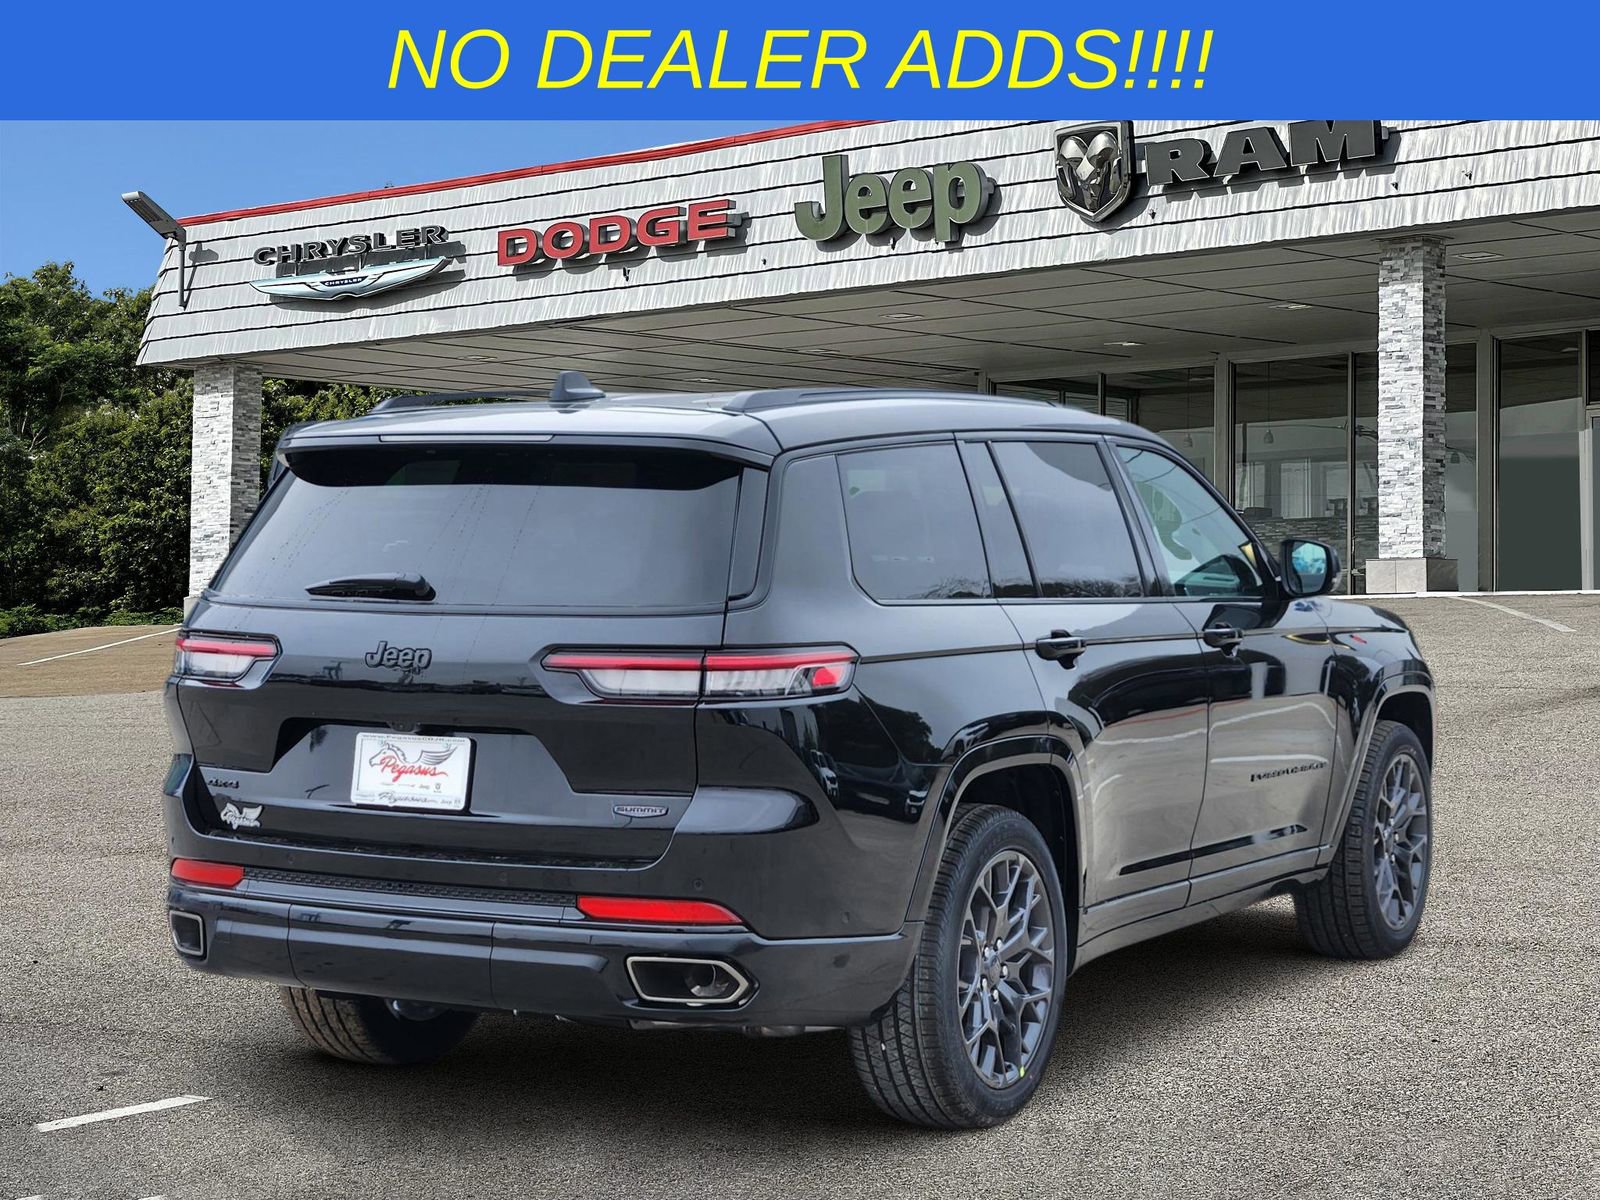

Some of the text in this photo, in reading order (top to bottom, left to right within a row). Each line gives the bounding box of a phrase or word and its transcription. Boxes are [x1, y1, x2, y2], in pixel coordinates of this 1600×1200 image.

[1145, 120, 1378, 187] RAM
[794, 154, 986, 243] Jeep
[254, 225, 447, 266] CHRYSLER
[497, 199, 735, 267] DODGE
[324, 278, 362, 286] CHRYSLER
[365, 640, 432, 675] Jeep
[380, 755, 448, 782] Pegasus
[616, 806, 664, 814] SUMMIT
